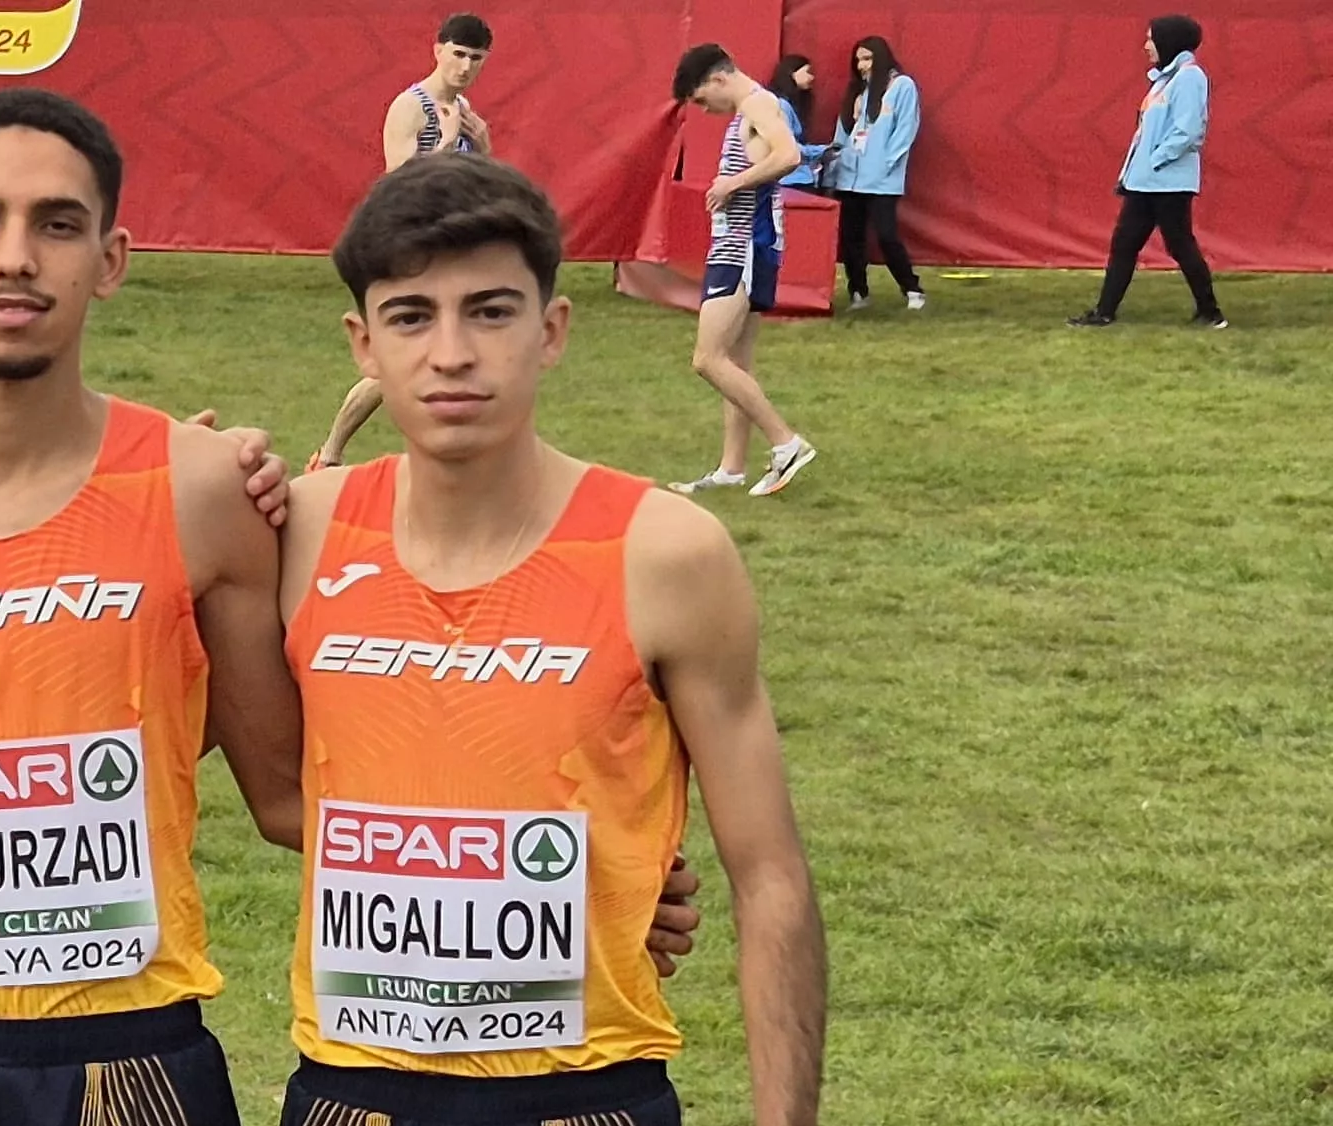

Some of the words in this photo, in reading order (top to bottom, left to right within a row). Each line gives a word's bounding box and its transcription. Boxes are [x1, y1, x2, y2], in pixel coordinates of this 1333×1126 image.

[310, 633, 591, 685] ESPAÑA
[324, 820, 500, 871] SPAR
[321, 888, 572, 960] MIGALLON
[62, 937, 145, 971] 2024
[366, 977, 372, 995] I
[376, 978, 424, 1000] RUN
[335, 1007, 469, 1043] ANTALYA
[479, 1010, 566, 1041] 2024
